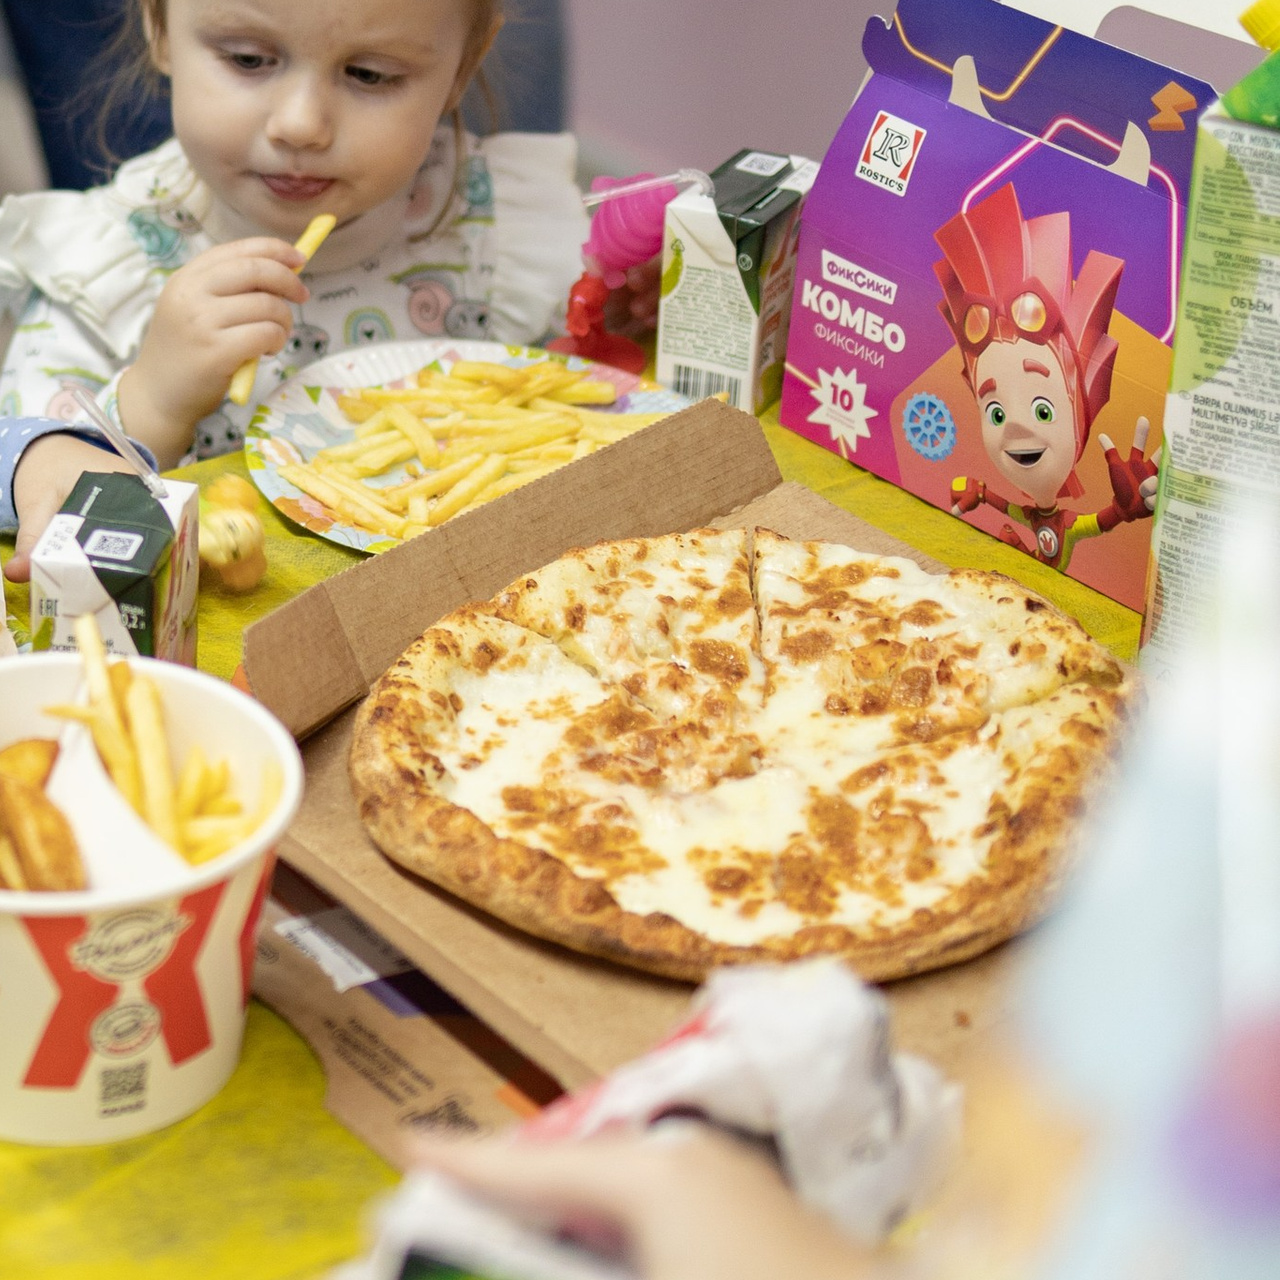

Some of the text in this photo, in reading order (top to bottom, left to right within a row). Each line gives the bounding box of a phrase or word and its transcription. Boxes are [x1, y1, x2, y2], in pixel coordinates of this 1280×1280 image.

[859, 166, 904, 192] ROSTIC'S
[801, 280, 906, 352] КОМБО
[815, 323, 885, 368] ФИКСИКИ
[831, 382, 853, 412] 10
